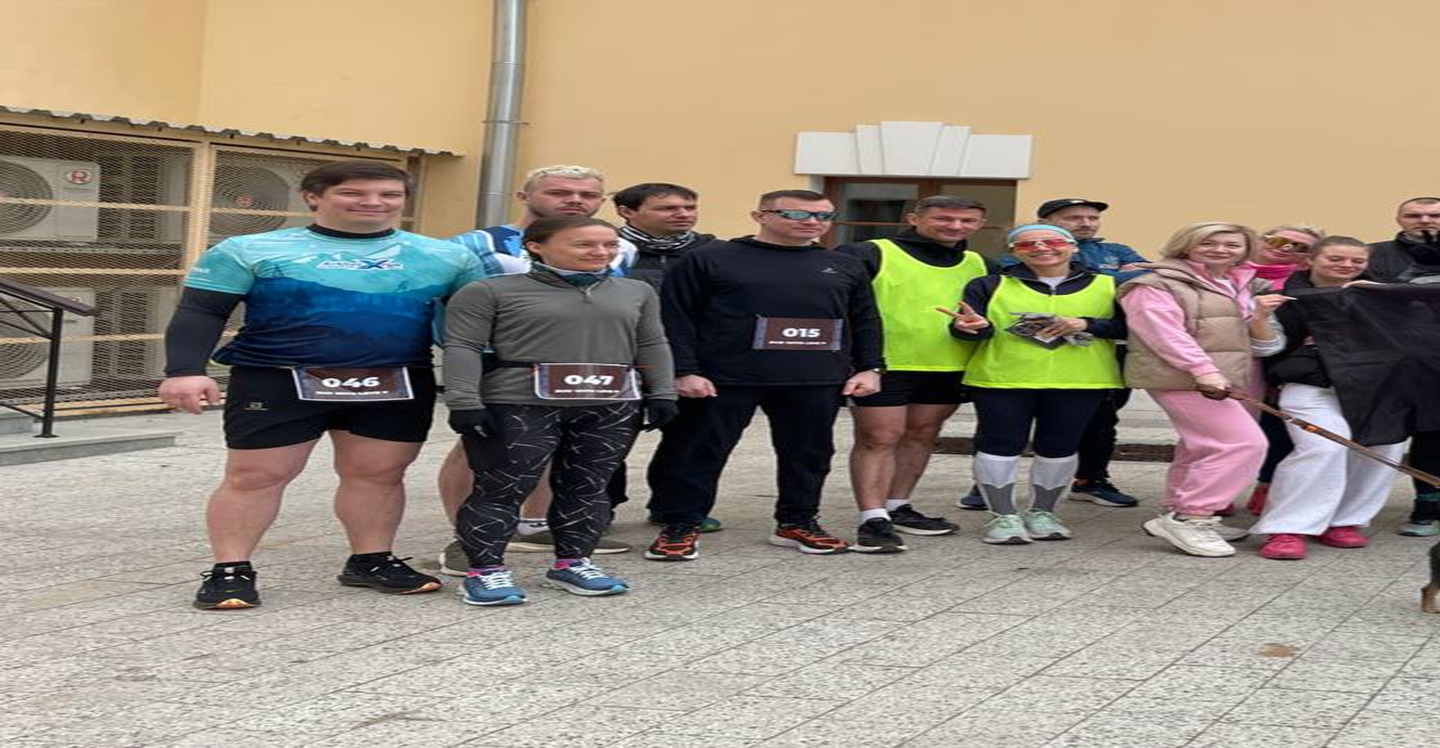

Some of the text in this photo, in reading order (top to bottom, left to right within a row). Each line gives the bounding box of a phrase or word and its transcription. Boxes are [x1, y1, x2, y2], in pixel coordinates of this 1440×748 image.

[782, 327, 820, 338] 015
[321, 377, 380, 388] 046
[564, 375, 614, 385] 047
